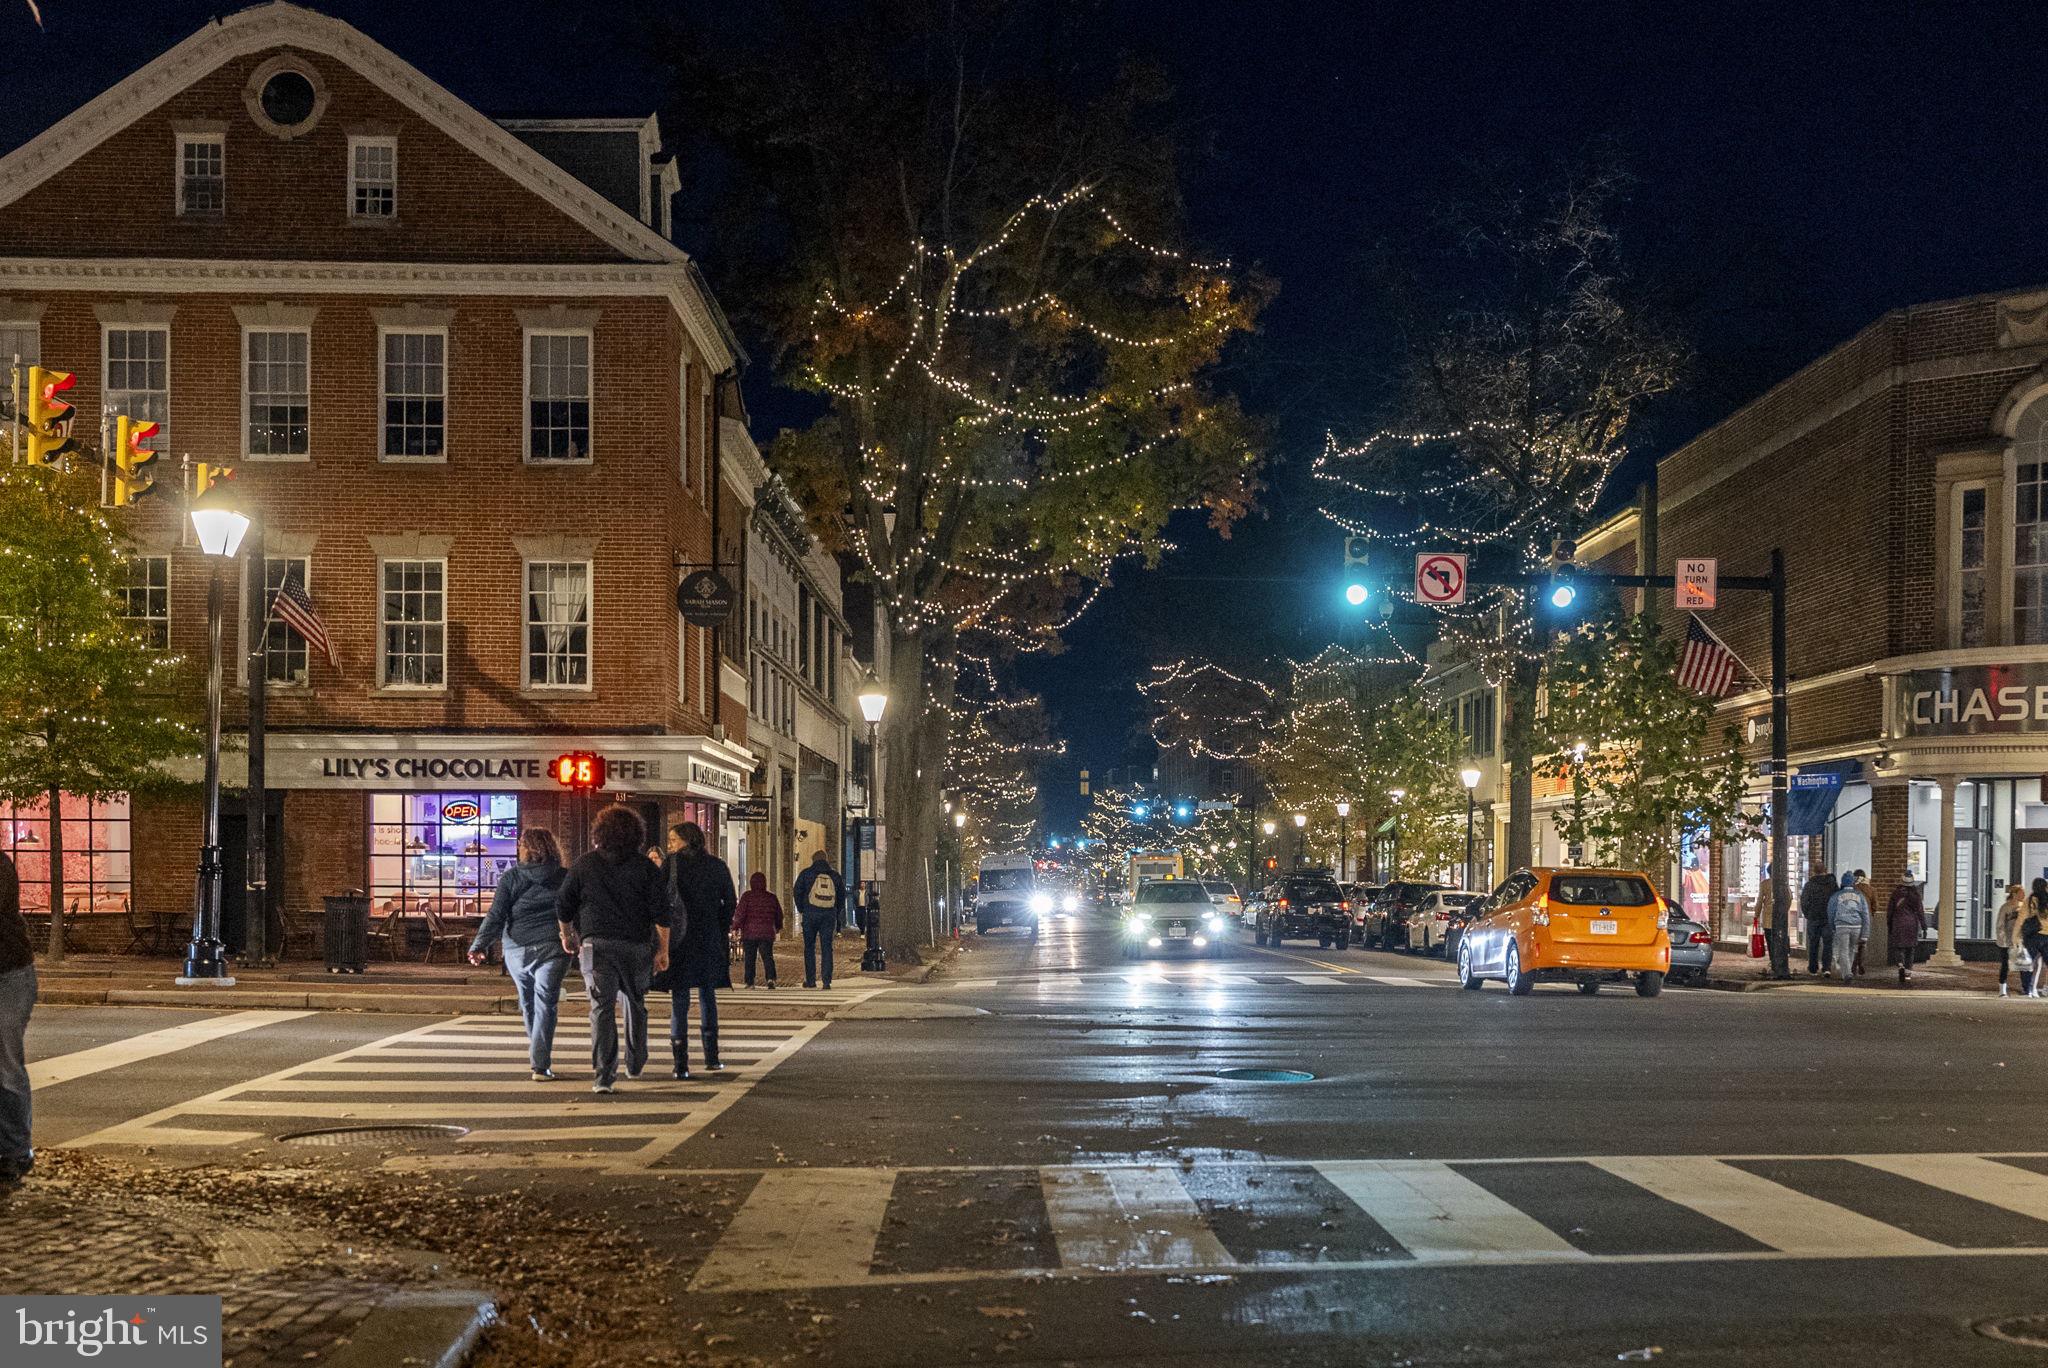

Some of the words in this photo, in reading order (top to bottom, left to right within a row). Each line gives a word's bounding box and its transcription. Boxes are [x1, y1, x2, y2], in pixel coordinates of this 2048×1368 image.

[1687, 563, 1705, 573] NO
[1686, 597, 1704, 605] RED
[1912, 685, 2048, 724] CHASE
[323, 758, 389, 777] LILY'S
[395, 758, 540, 778] CHOCOLATE
[578, 761, 591, 781] 15
[1797, 776, 1829, 788] Washington
[615, 792, 626, 802] 631
[445, 806, 478, 817] OPEN
